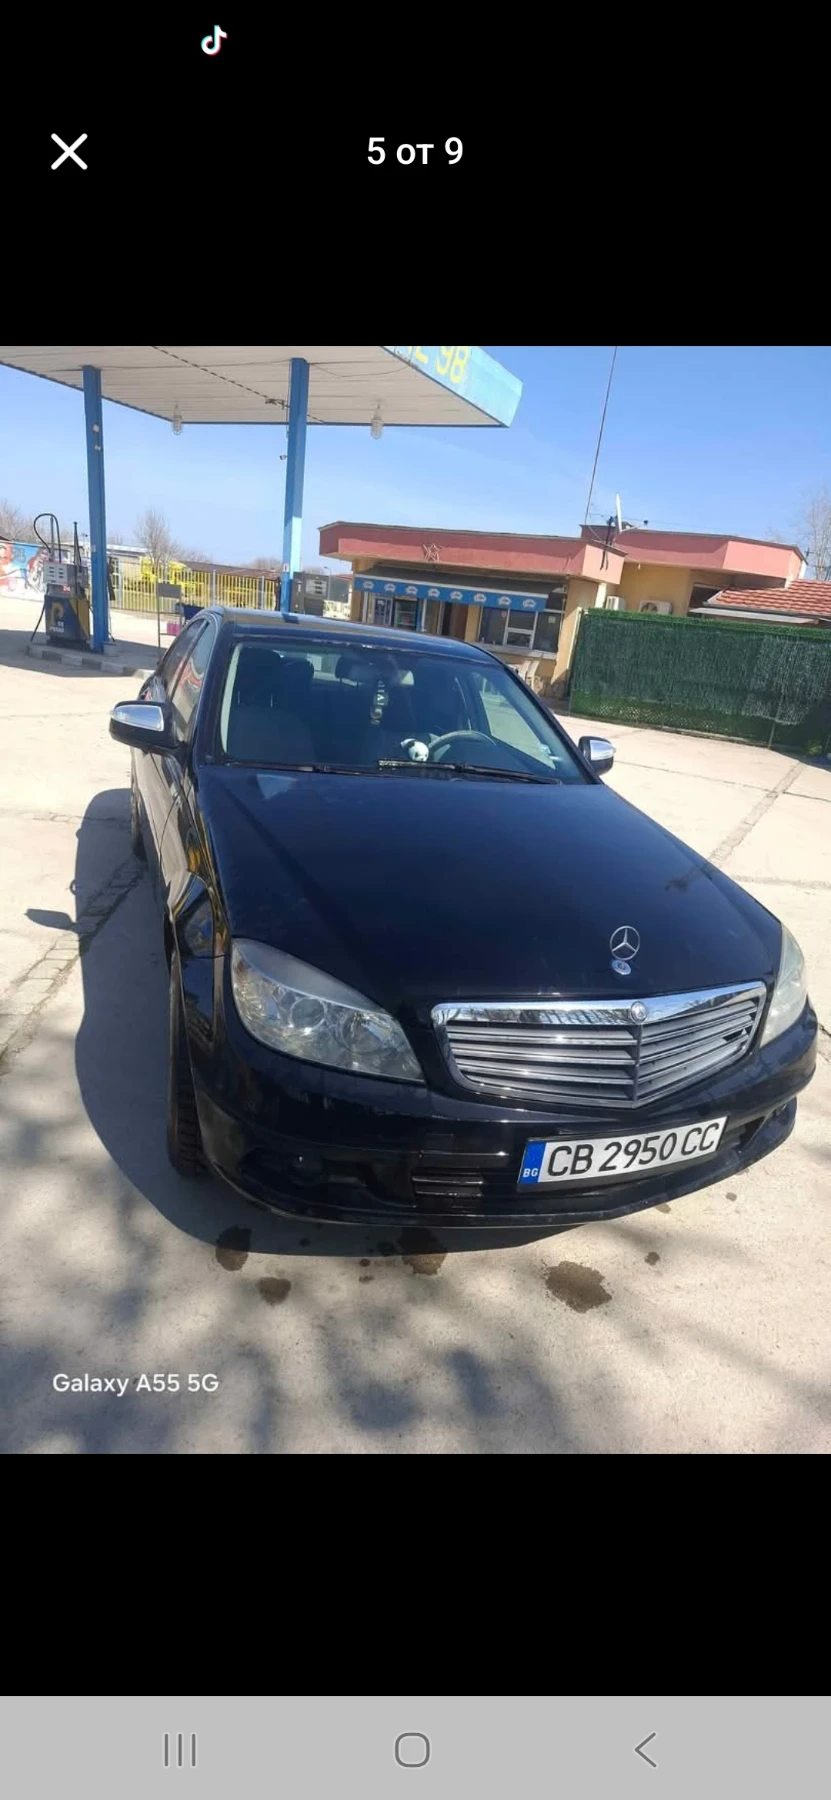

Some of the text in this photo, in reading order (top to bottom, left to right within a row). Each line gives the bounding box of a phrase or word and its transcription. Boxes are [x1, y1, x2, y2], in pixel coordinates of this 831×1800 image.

[547, 1122, 720, 1176] CB 2950 CC
[522, 1167, 539, 1178] BG
